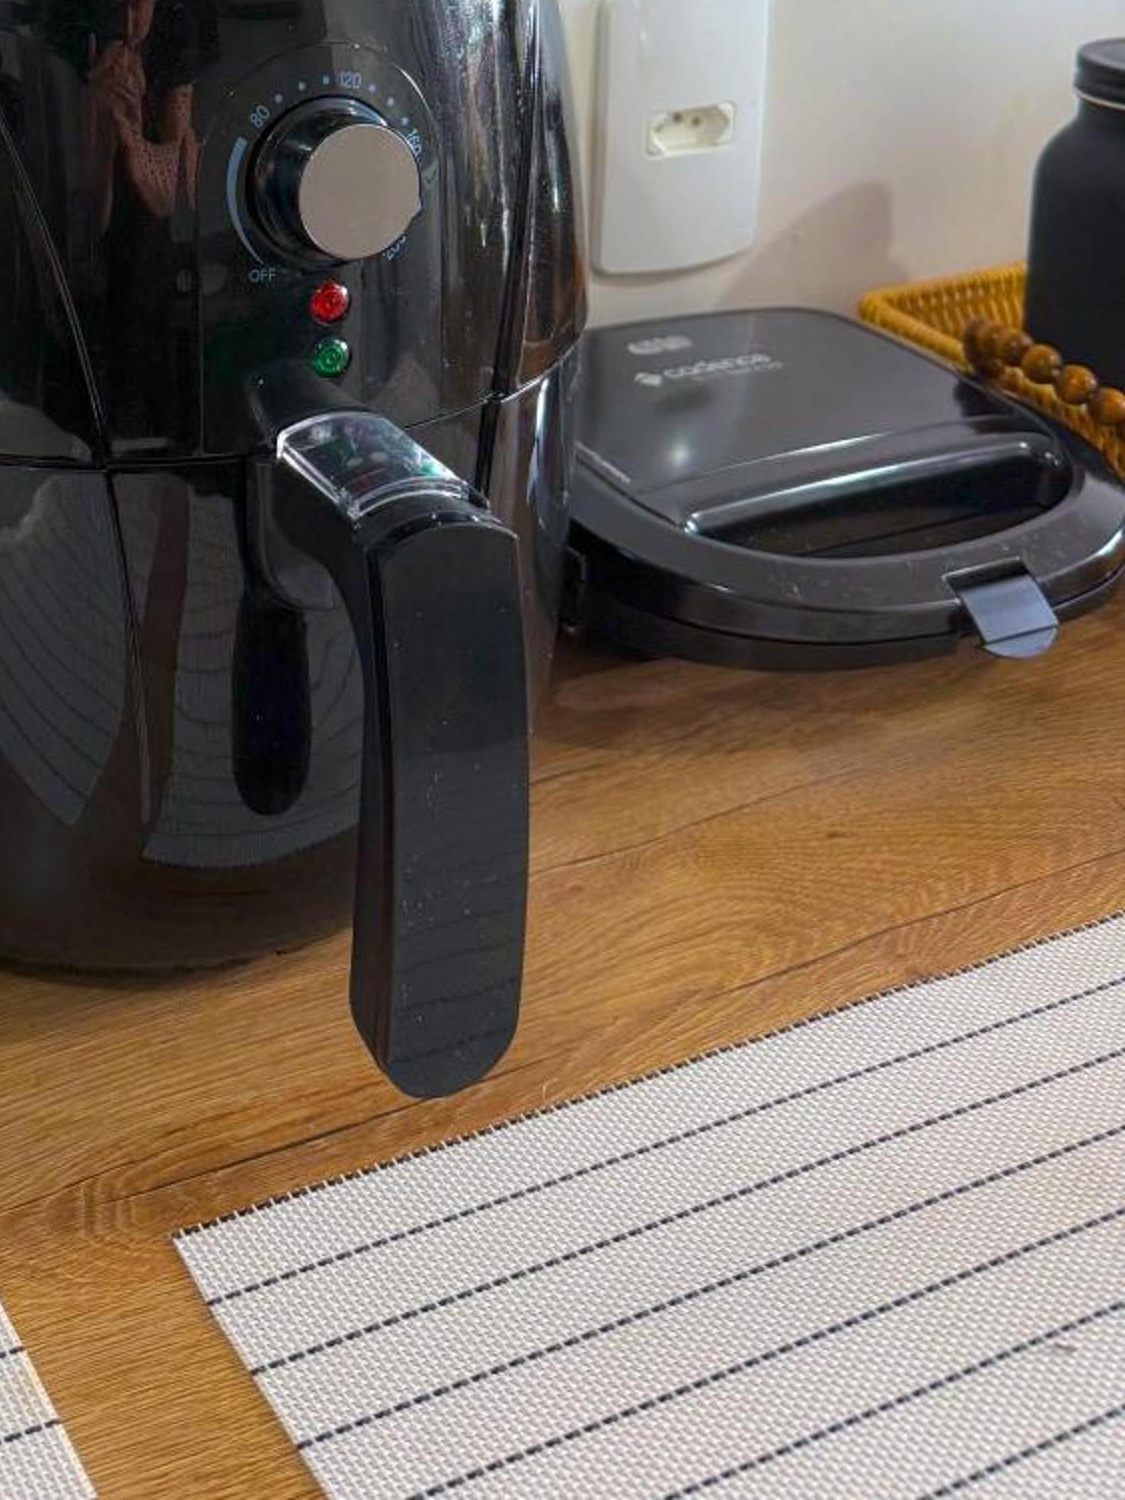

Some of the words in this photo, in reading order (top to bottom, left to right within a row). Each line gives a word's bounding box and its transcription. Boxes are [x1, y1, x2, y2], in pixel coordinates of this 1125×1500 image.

[340, 71, 363, 90] 120
[250, 105, 271, 128] 80
[250, 267, 277, 284] OFF
